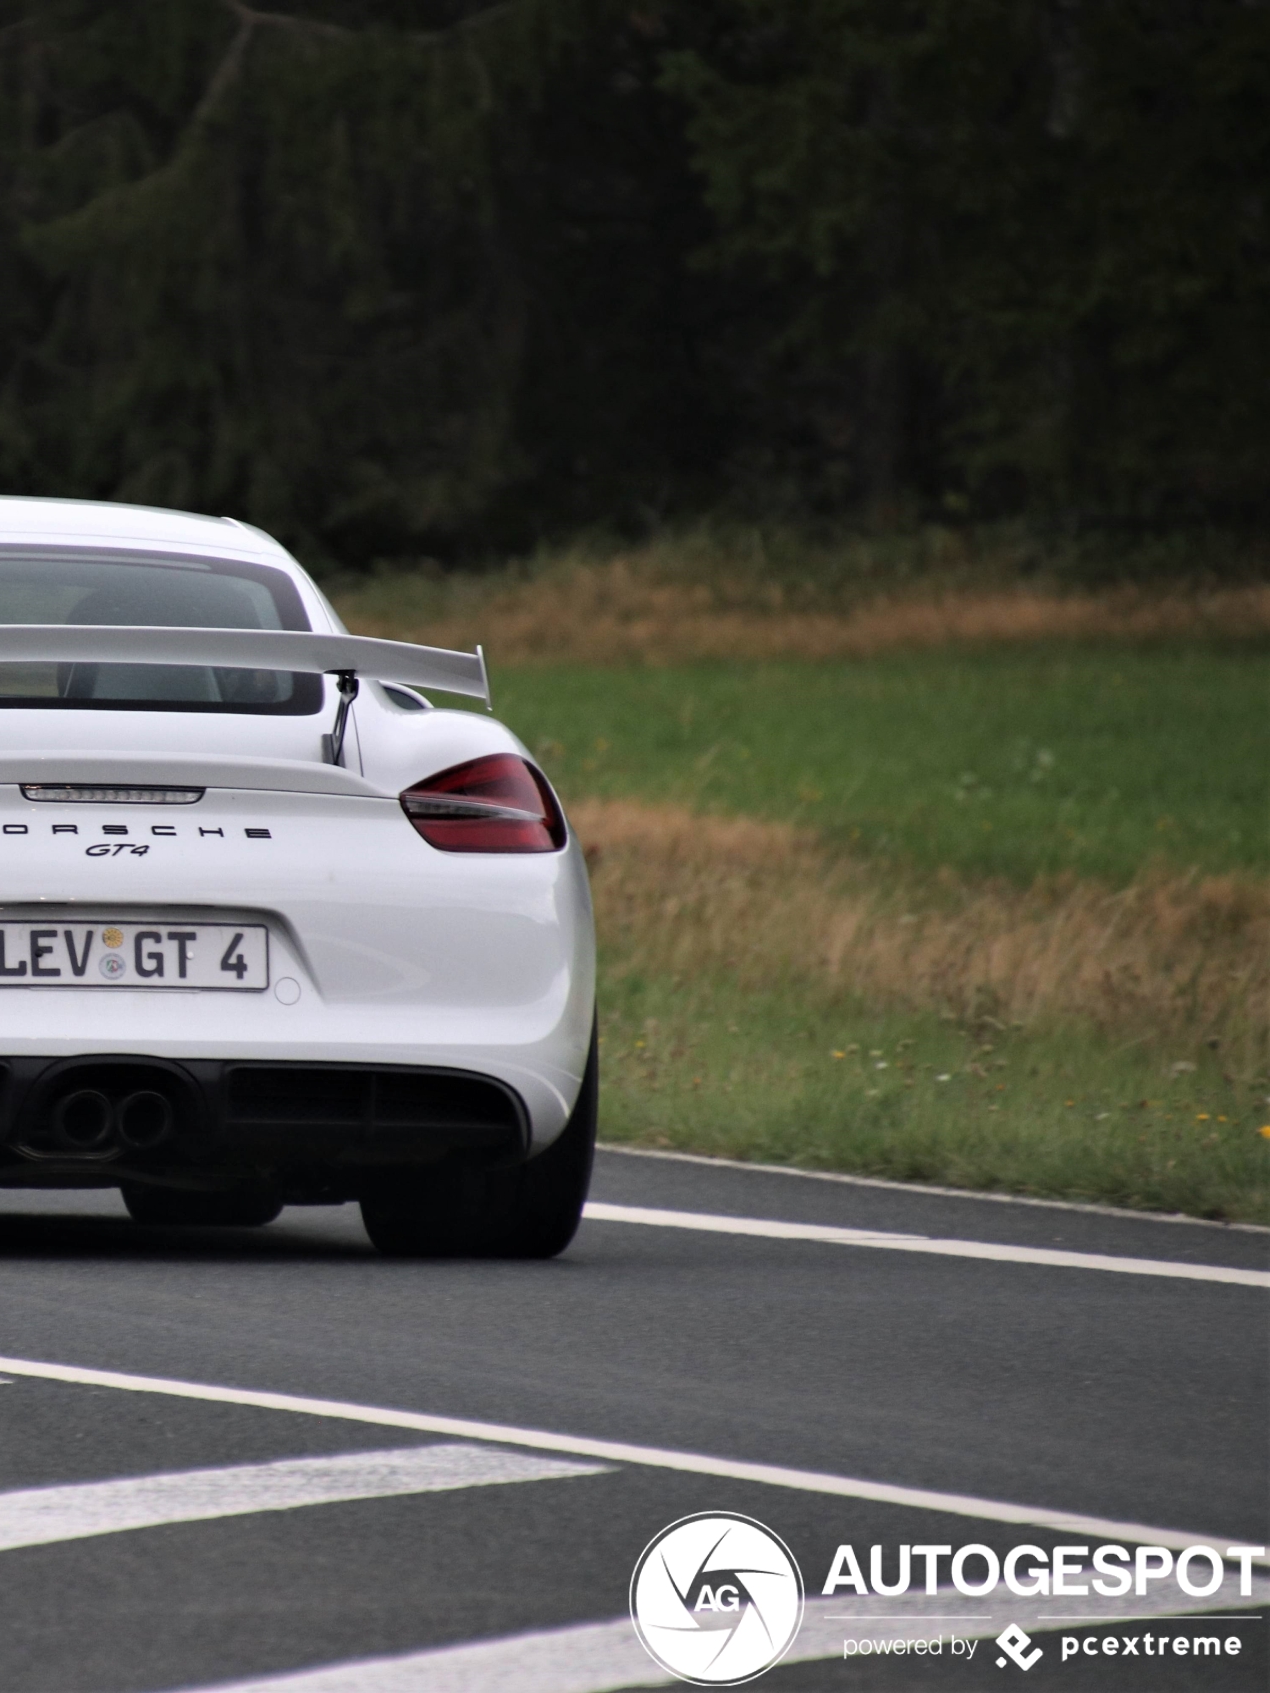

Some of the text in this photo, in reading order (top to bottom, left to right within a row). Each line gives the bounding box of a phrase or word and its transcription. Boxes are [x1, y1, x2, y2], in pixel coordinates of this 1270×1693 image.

[85, 843, 150, 857] GT4
[133, 930, 197, 979] GT
[220, 932, 248, 980] 4
